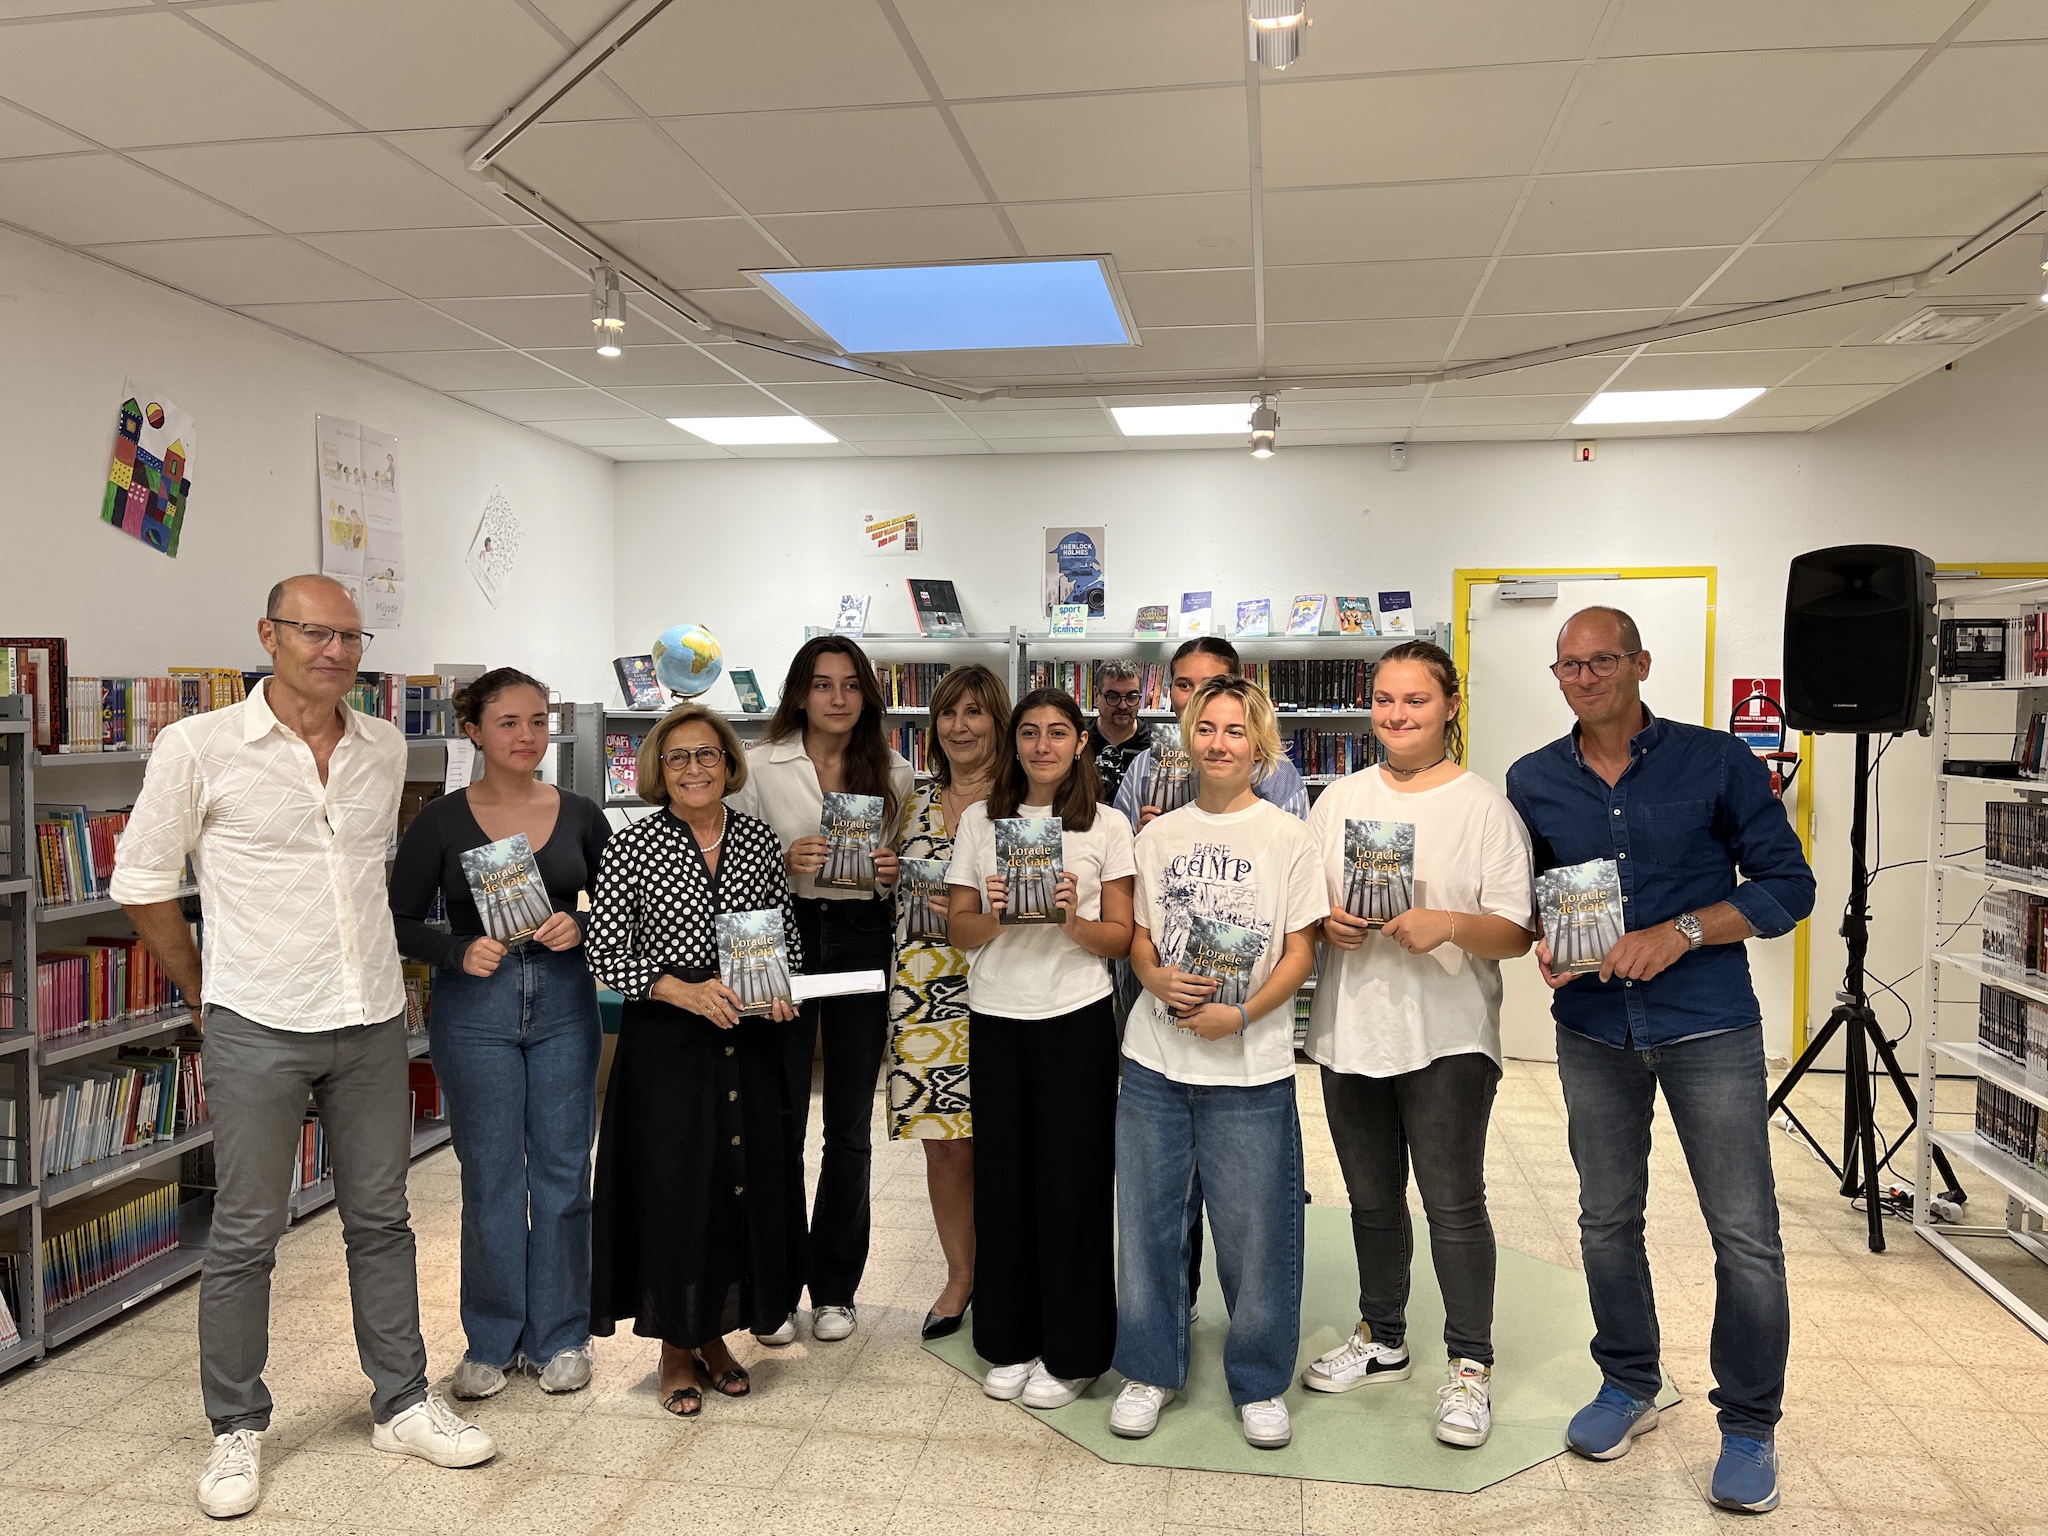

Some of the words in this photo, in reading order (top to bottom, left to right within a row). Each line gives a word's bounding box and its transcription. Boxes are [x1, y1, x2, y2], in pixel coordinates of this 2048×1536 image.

[1059, 605, 1081, 614] sport
[1052, 625, 1084, 634] science
[606, 735, 629, 747] OKAPI
[1160, 747, 1189, 758] L'orac
[1159, 757, 1172, 767] de
[1174, 759, 1189, 768] Ga
[832, 816, 871, 830] L'oracle
[830, 827, 844, 837] de
[845, 828, 869, 839] Gaïa
[1008, 844, 1051, 856] L'oracle
[1193, 842, 1231, 857] BASE
[1356, 846, 1400, 860] L'oracle
[1007, 856, 1022, 867] de
[1024, 855, 1051, 867] Gaïa
[1354, 858, 1369, 870] de
[1372, 859, 1400, 872] Gaïa
[480, 863, 525, 885] L'oracle
[483, 884, 499, 895] de
[500, 873, 528, 889] Gaïa
[1559, 888, 1607, 904] L'oracle
[1558, 903, 1574, 915] de
[1577, 900, 1607, 912] Gaïa
[730, 934, 774, 949] L'oracle
[730, 948, 745, 959] de
[748, 945, 775, 957] Gaïa
[1197, 943, 1243, 965] L'oracle
[1193, 955, 1209, 968] de
[1211, 958, 1239, 975] Gaïa
[1463, 1366, 1476, 1375] NIKE
